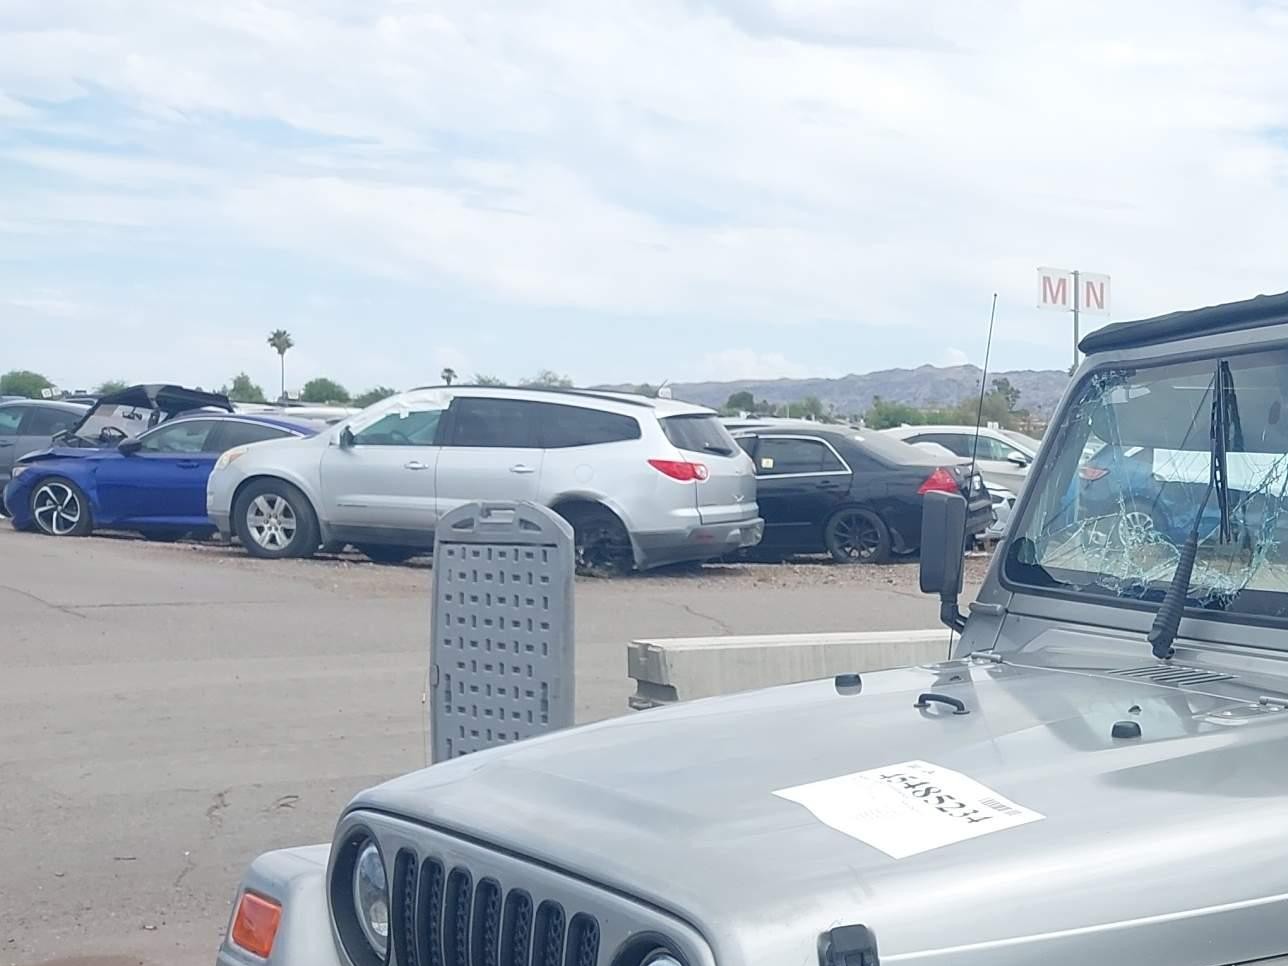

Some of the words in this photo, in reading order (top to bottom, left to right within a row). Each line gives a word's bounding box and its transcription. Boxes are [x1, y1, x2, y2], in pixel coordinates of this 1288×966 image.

[1042, 276, 1066, 305] M
[1086, 280, 1104, 309] N
[879, 773, 993, 824] 45485234
